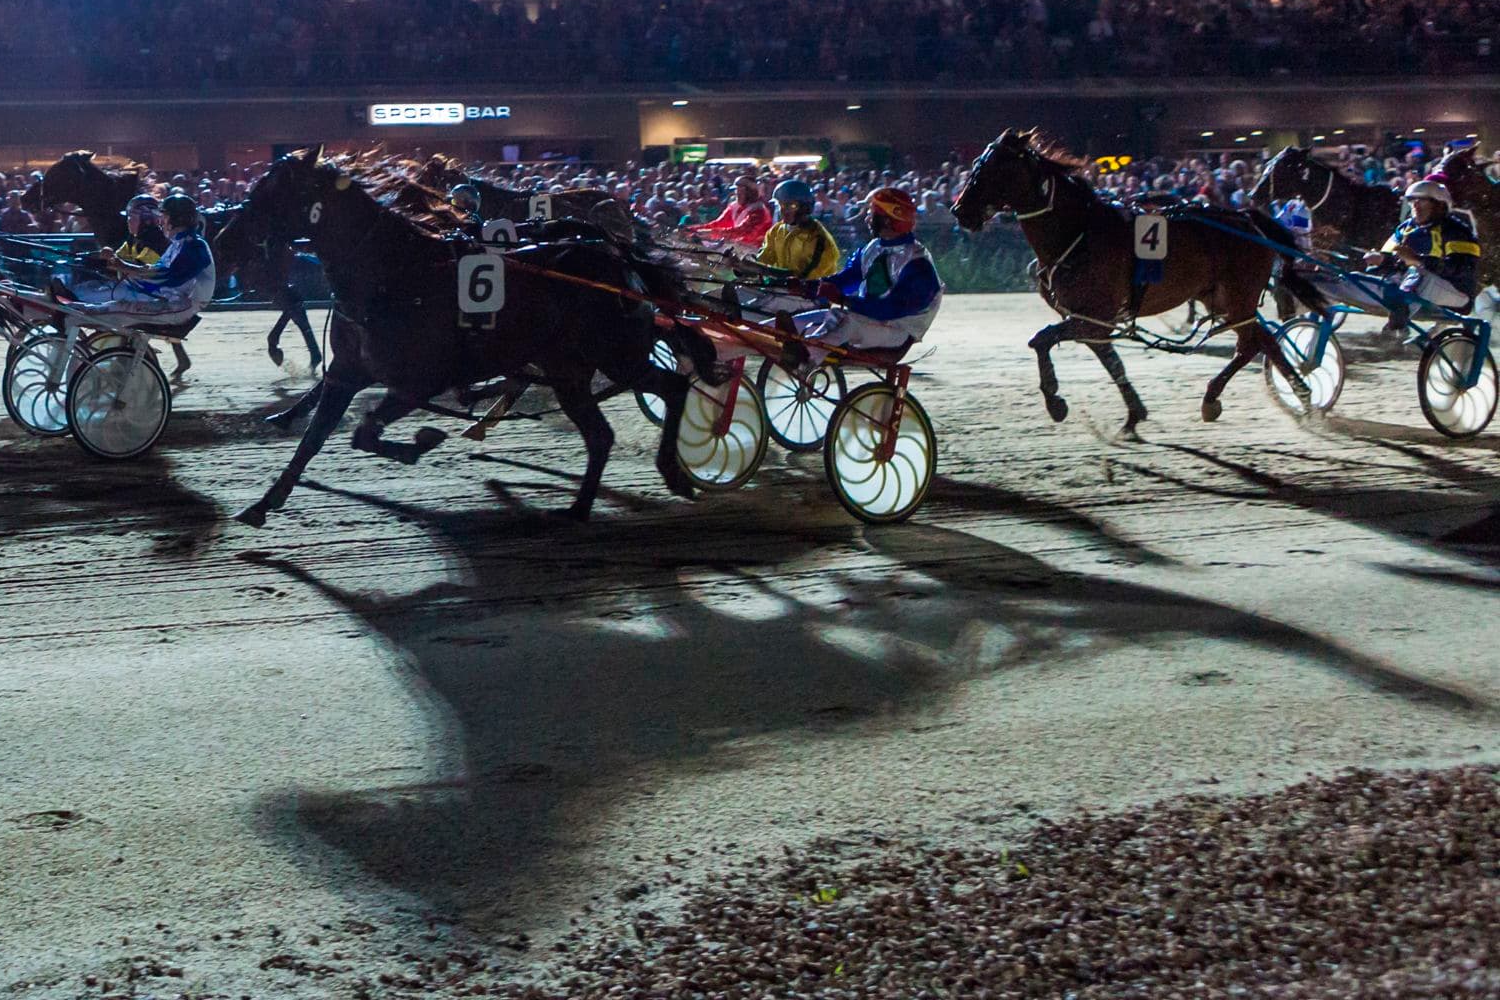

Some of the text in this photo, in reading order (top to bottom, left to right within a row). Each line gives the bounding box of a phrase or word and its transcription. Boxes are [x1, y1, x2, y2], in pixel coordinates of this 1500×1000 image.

[374, 106, 511, 119] SPORTS BAR
[309, 202, 322, 224] 6
[534, 200, 547, 220] 5
[1141, 222, 1160, 251] 4
[468, 264, 495, 303] 6
